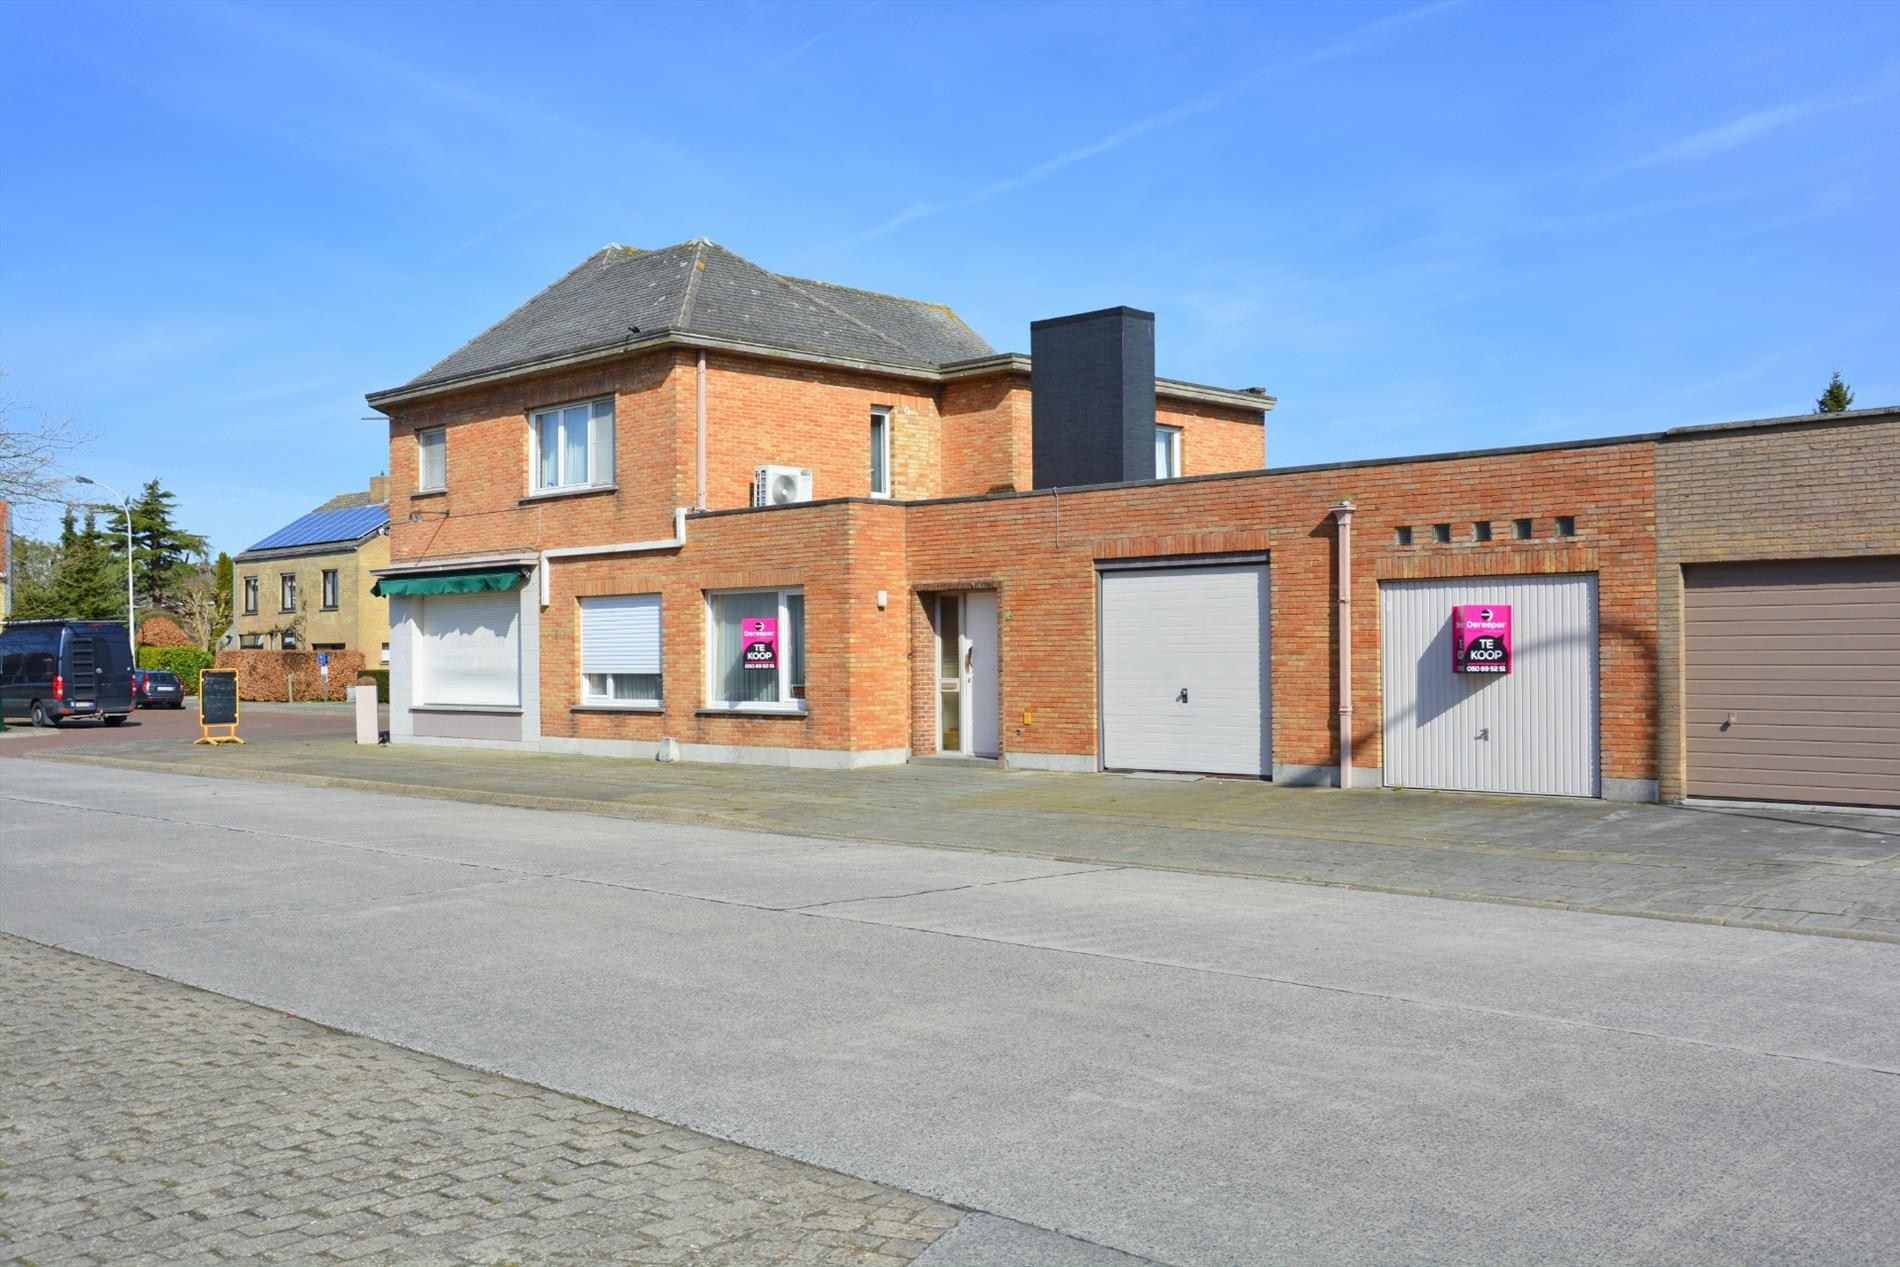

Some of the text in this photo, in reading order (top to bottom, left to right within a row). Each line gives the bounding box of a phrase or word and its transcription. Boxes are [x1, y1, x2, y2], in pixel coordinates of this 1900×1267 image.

[1479, 639, 1494, 648] TE
[747, 652, 772, 660] KOOP
[1470, 650, 1502, 660] KOOP
